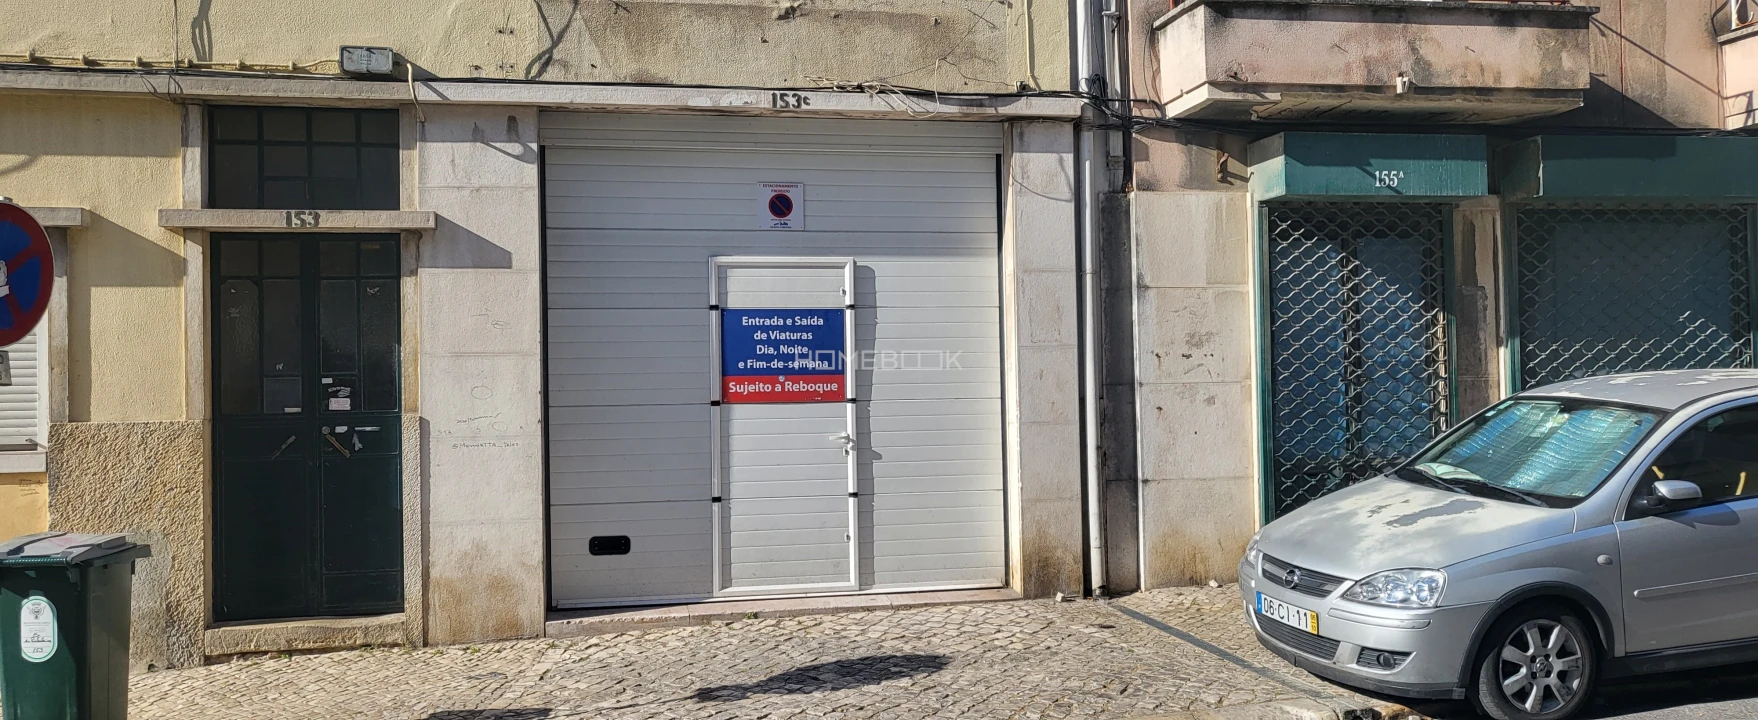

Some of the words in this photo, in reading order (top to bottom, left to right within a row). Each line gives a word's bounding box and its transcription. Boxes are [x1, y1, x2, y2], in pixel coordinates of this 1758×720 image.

[285, 210, 320, 228] 153
[742, 316, 784, 326] Entrada
[786, 318, 793, 326] e
[794, 316, 824, 326] Saída
[753, 330, 768, 340] de
[769, 330, 813, 340] Viaturas
[756, 345, 777, 355] Dia,
[780, 345, 809, 354] Noite
[738, 360, 745, 369] e
[747, 359, 829, 369] Fim-de-semana
[728, 381, 772, 395] Sujeito
[774, 383, 782, 392] a
[784, 381, 839, 394] Reboque
